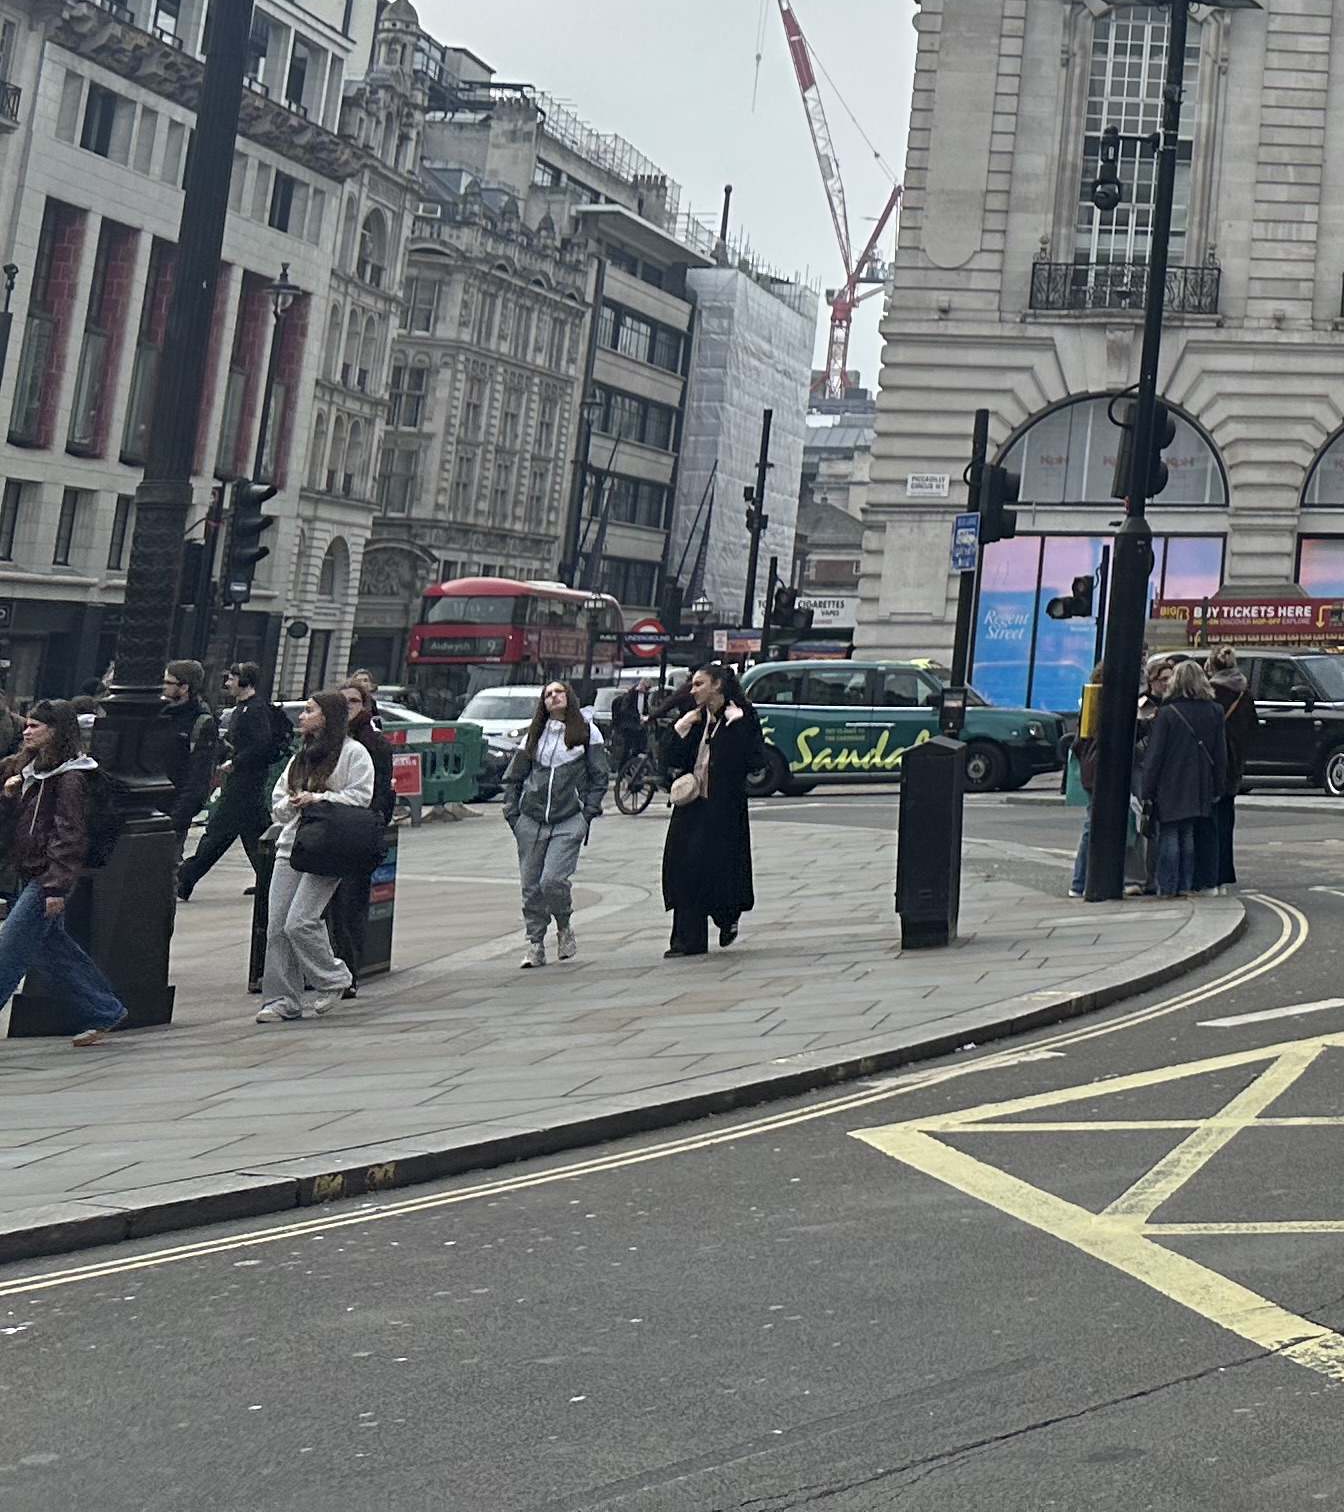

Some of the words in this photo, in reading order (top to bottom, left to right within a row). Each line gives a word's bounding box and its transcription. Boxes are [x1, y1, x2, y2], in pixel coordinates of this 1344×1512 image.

[1222, 605, 1275, 618] TICKETS
[1278, 605, 1312, 617] HERE
[984, 609, 1030, 629] Regent
[986, 625, 1025, 640] Street
[487, 640, 497, 654] 9
